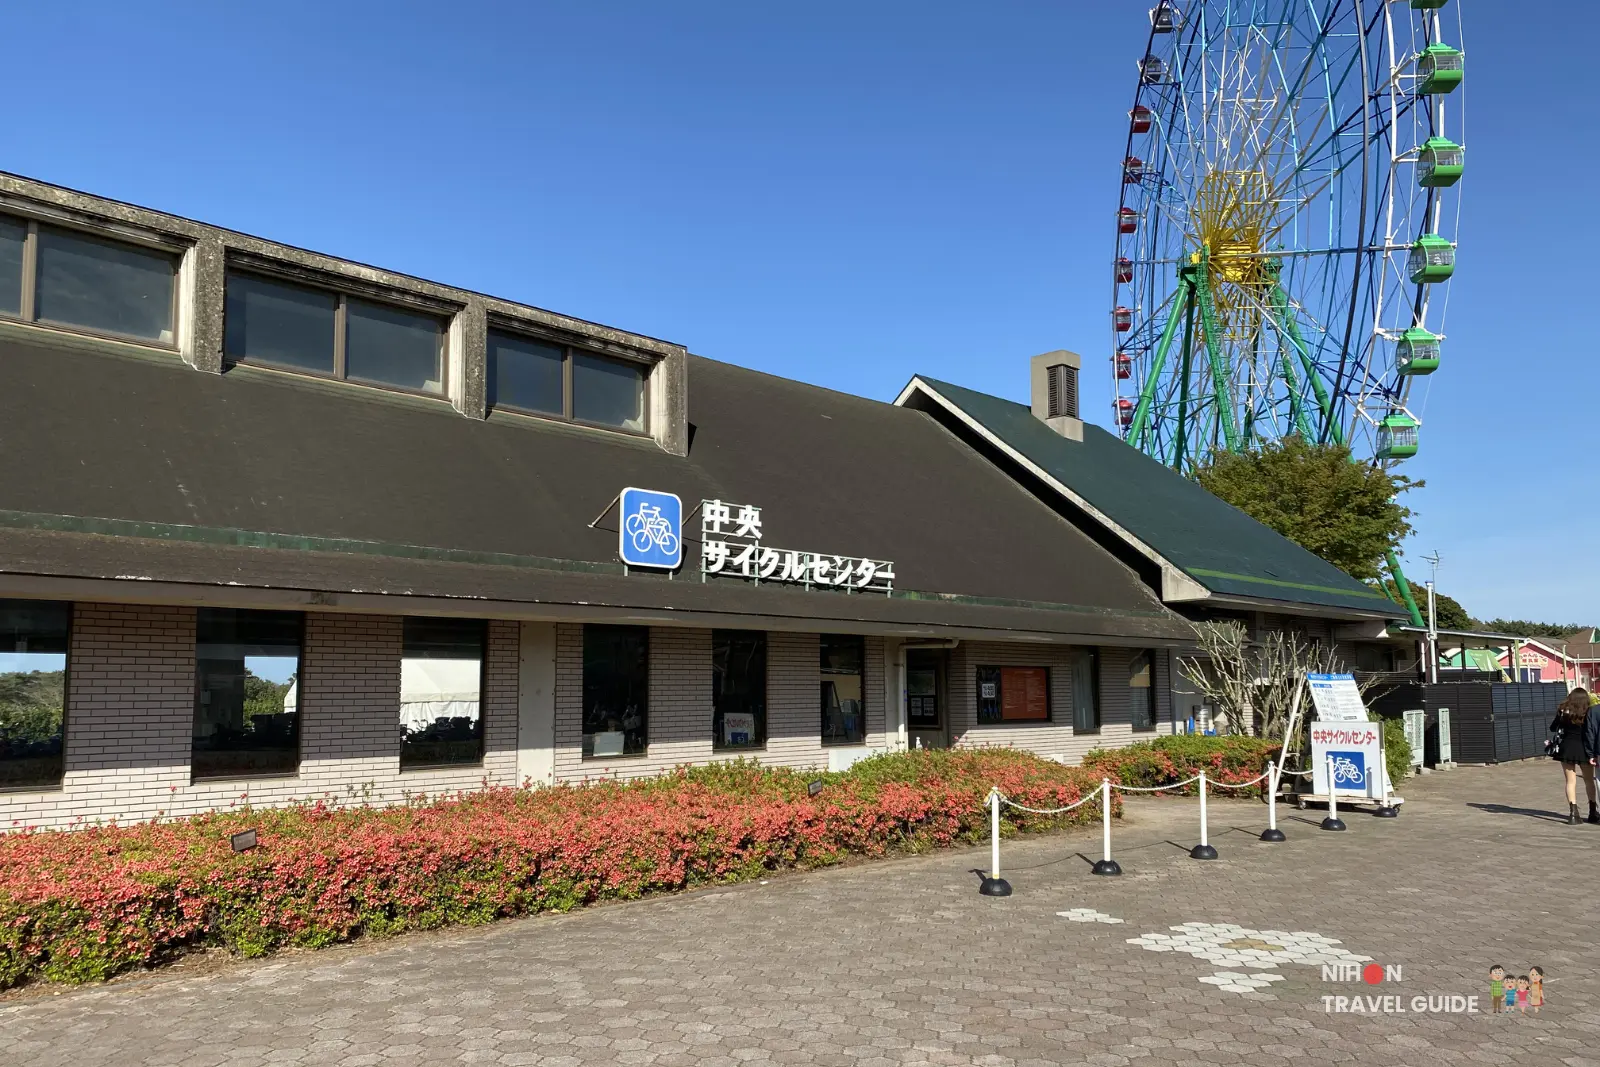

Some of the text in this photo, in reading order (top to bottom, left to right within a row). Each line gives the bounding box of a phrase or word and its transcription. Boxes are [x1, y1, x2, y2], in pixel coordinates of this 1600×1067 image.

[704, 499, 762, 539] 中央
[704, 541, 895, 587] サイクルセンター
[1313, 729, 1377, 746] 中央サイクルセンター
